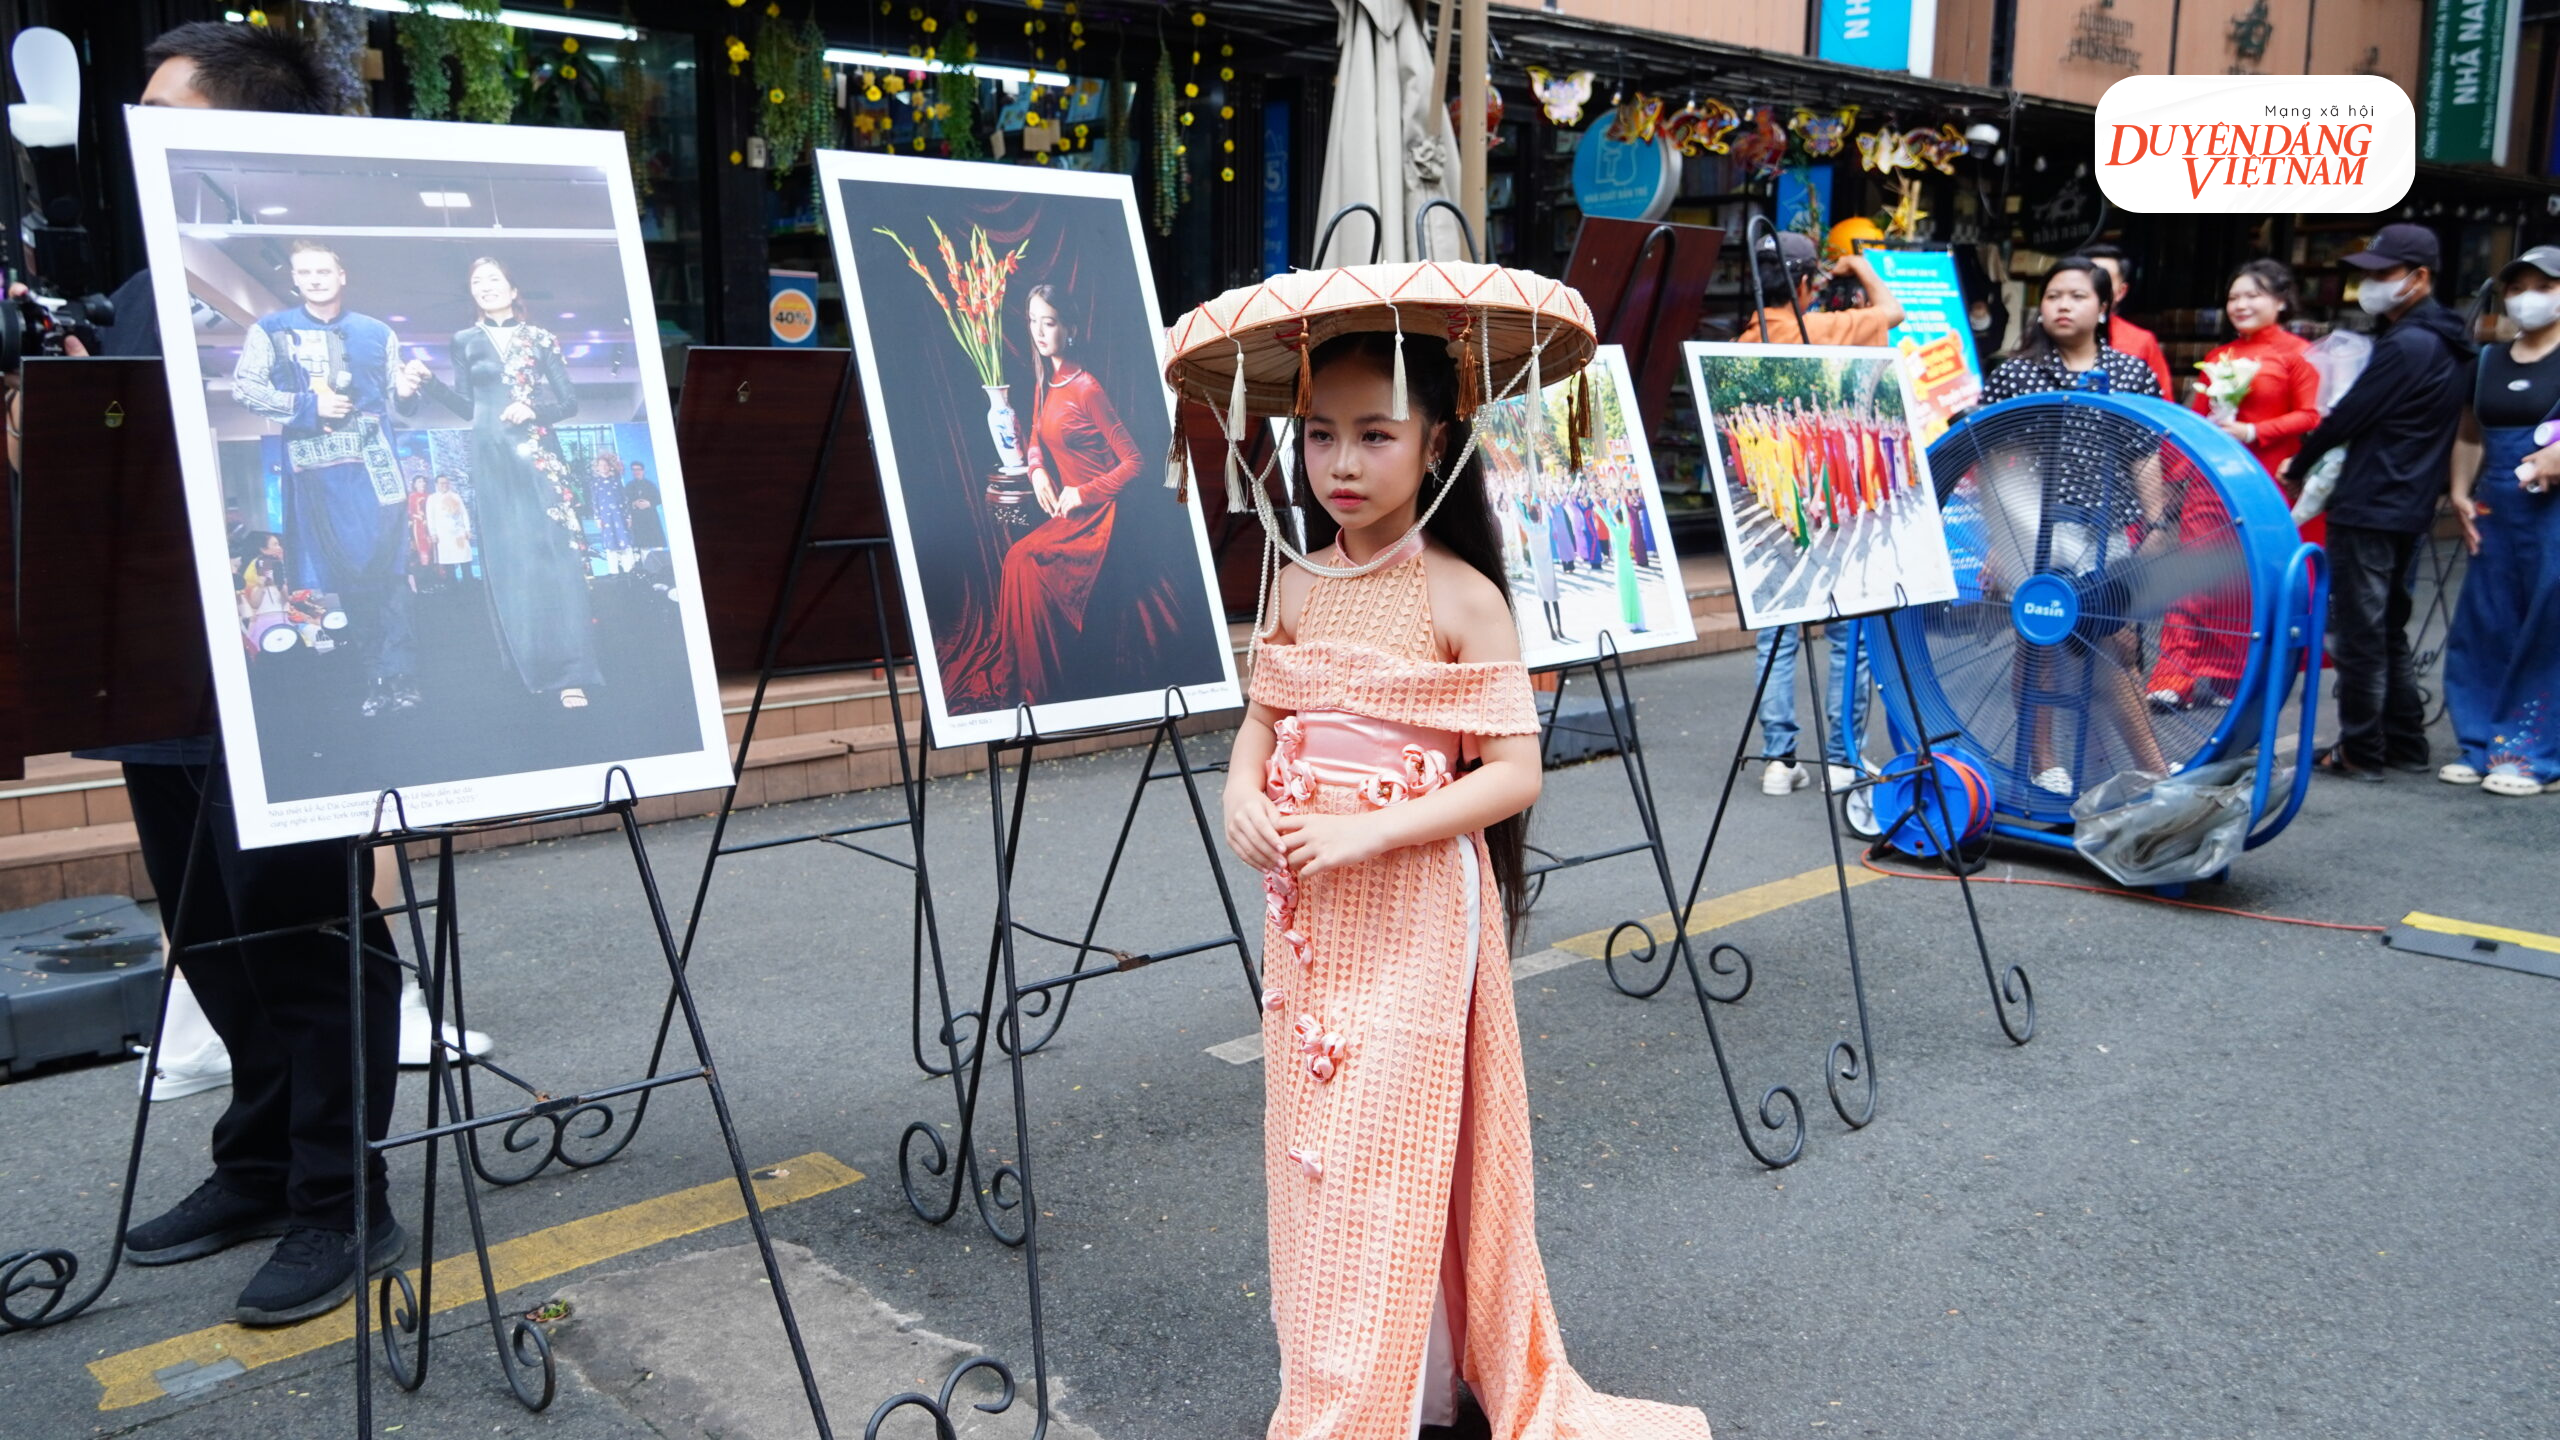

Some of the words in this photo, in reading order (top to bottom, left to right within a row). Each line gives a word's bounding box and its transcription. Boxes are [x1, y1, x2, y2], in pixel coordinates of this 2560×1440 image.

[2450, 47, 2481, 105] NHÃ
[776, 311, 810, 326] 40%
[2024, 600, 2065, 618] Dasin
